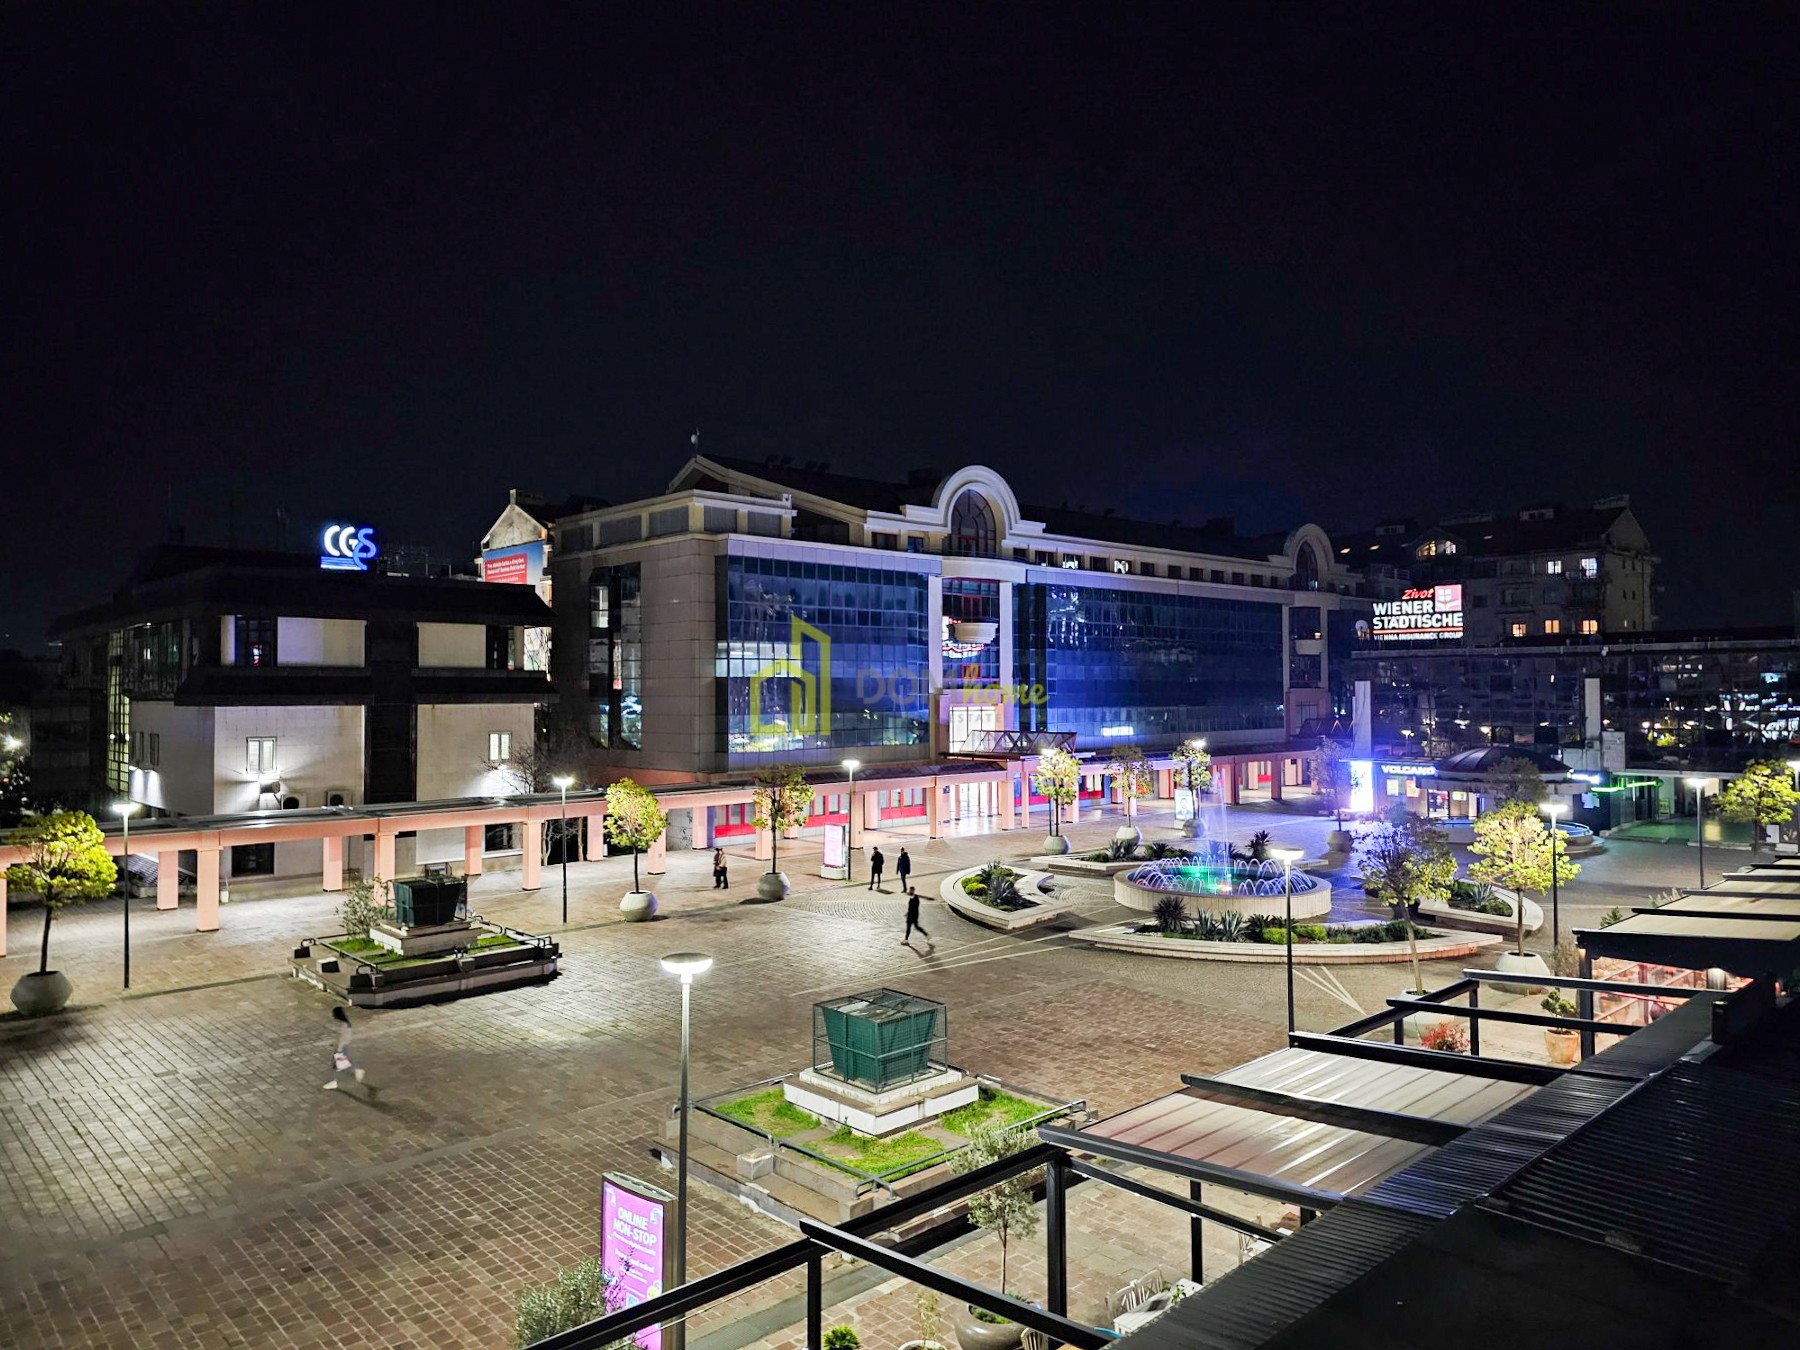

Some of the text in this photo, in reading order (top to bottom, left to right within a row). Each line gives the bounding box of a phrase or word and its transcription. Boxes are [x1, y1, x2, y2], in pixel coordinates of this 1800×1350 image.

[1373, 600, 1434, 615] WIENER
[1439, 631, 1464, 639] GROUP
[1381, 765, 1435, 775] VOLCANO
[618, 1206, 648, 1231] ONLINE
[614, 1218, 656, 1246] NON-STOP
